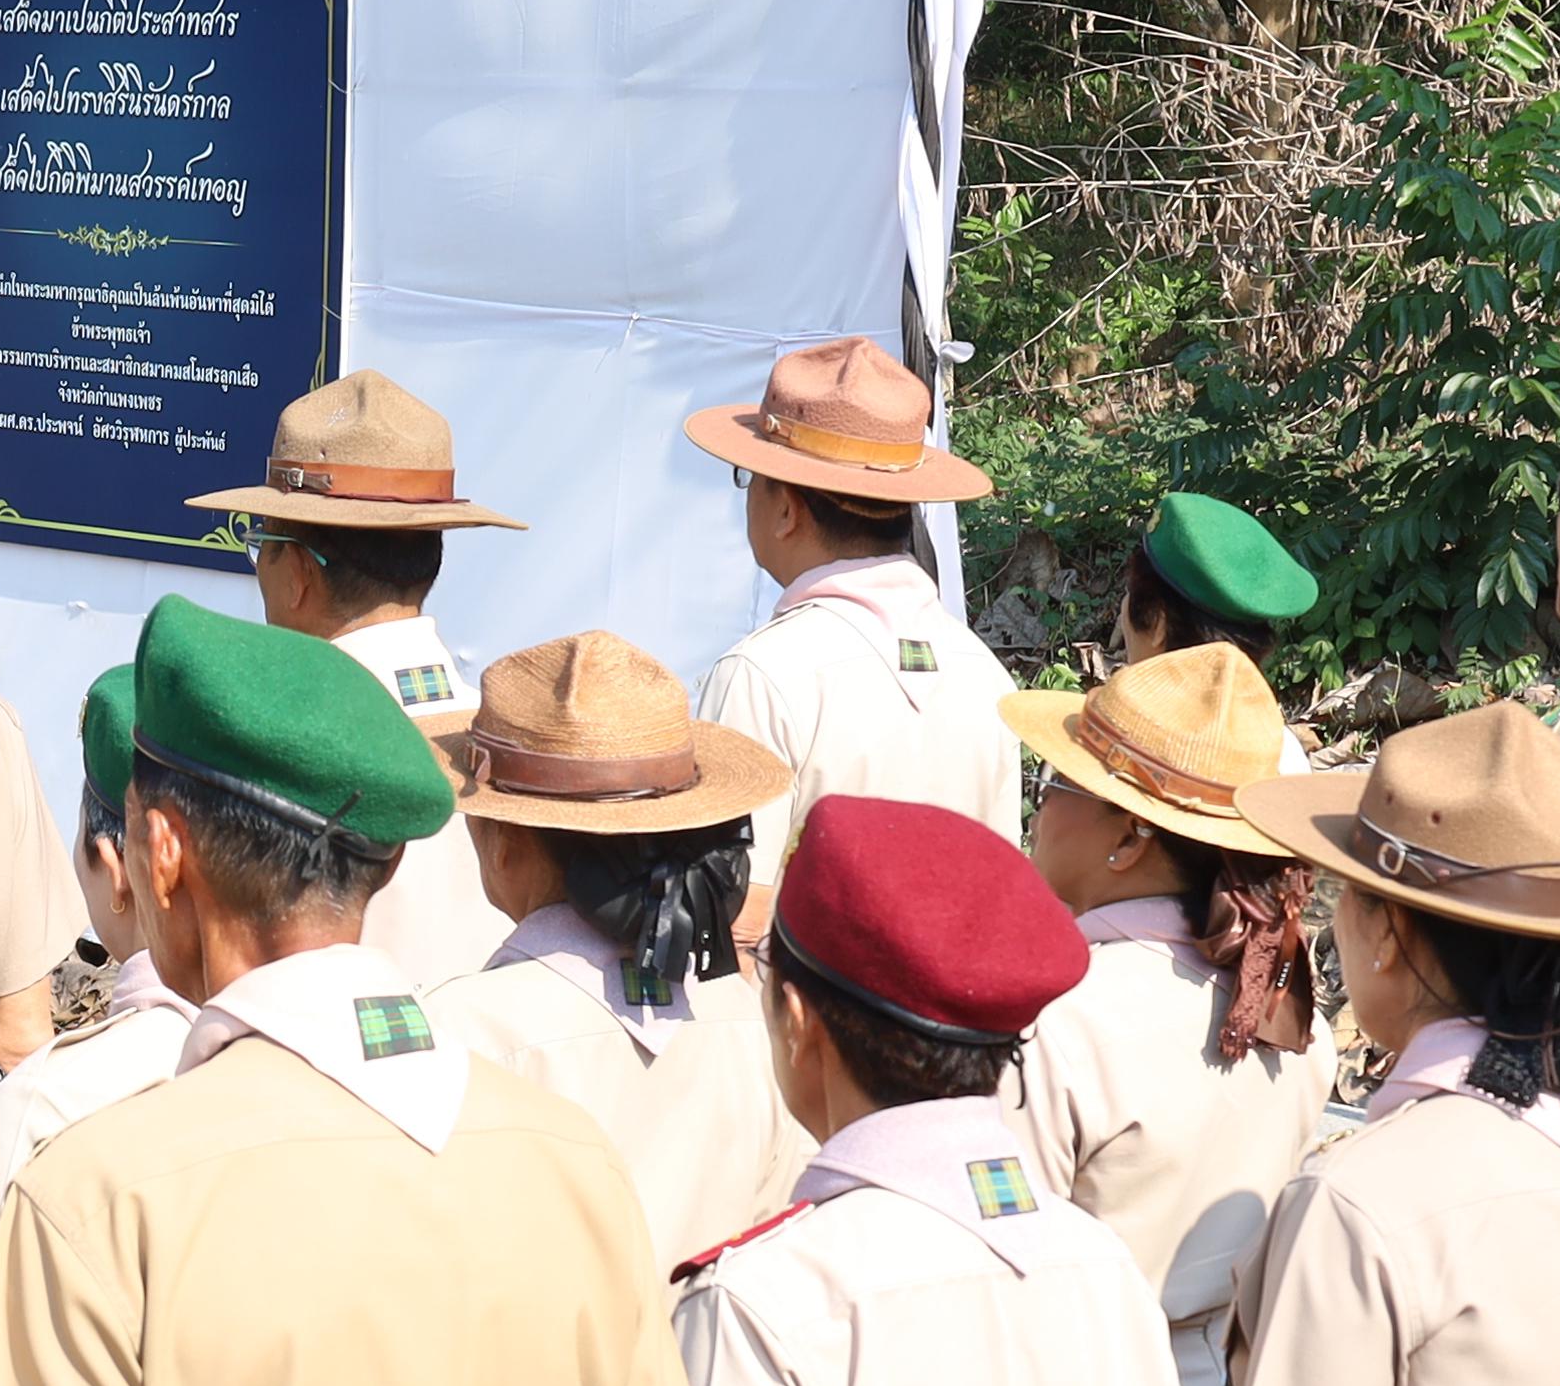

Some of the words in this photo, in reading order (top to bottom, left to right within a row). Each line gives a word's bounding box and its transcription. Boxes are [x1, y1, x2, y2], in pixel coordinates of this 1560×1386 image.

[71, 315, 151, 349] ข้าพระพุทธเจ้า
[58, 380, 162, 412] จังหวัดกำแพงเพชร
[175, 426, 226, 454] ผู้ประพันธ์
